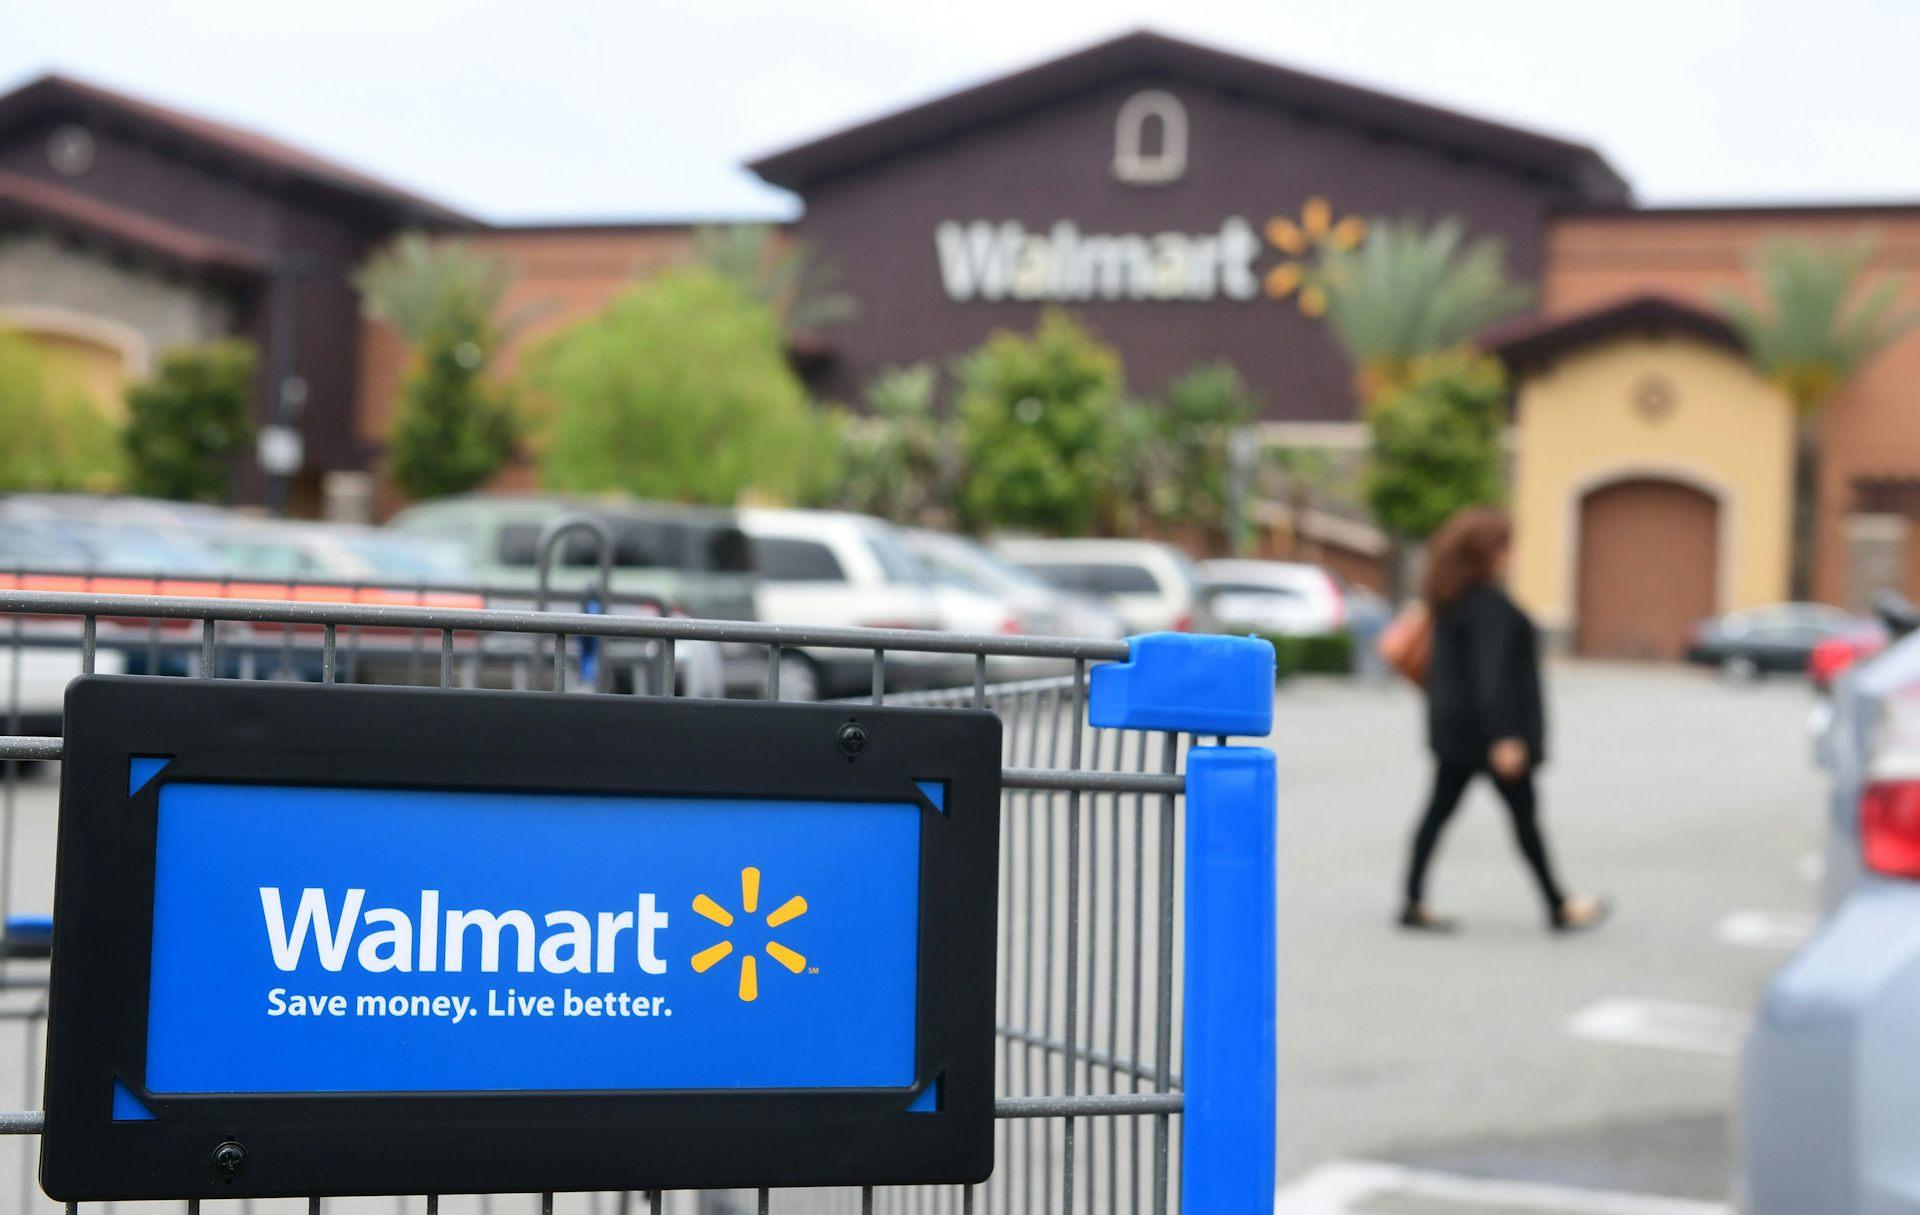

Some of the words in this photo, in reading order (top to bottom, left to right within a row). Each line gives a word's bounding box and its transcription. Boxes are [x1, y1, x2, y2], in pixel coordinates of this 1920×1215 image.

[935, 217, 1259, 302] Walmart
[259, 886, 669, 974] Walmart
[267, 988, 347, 1017] Save
[356, 995, 478, 1024] money.
[488, 988, 555, 1017] Live
[563, 988, 672, 1017] better.
